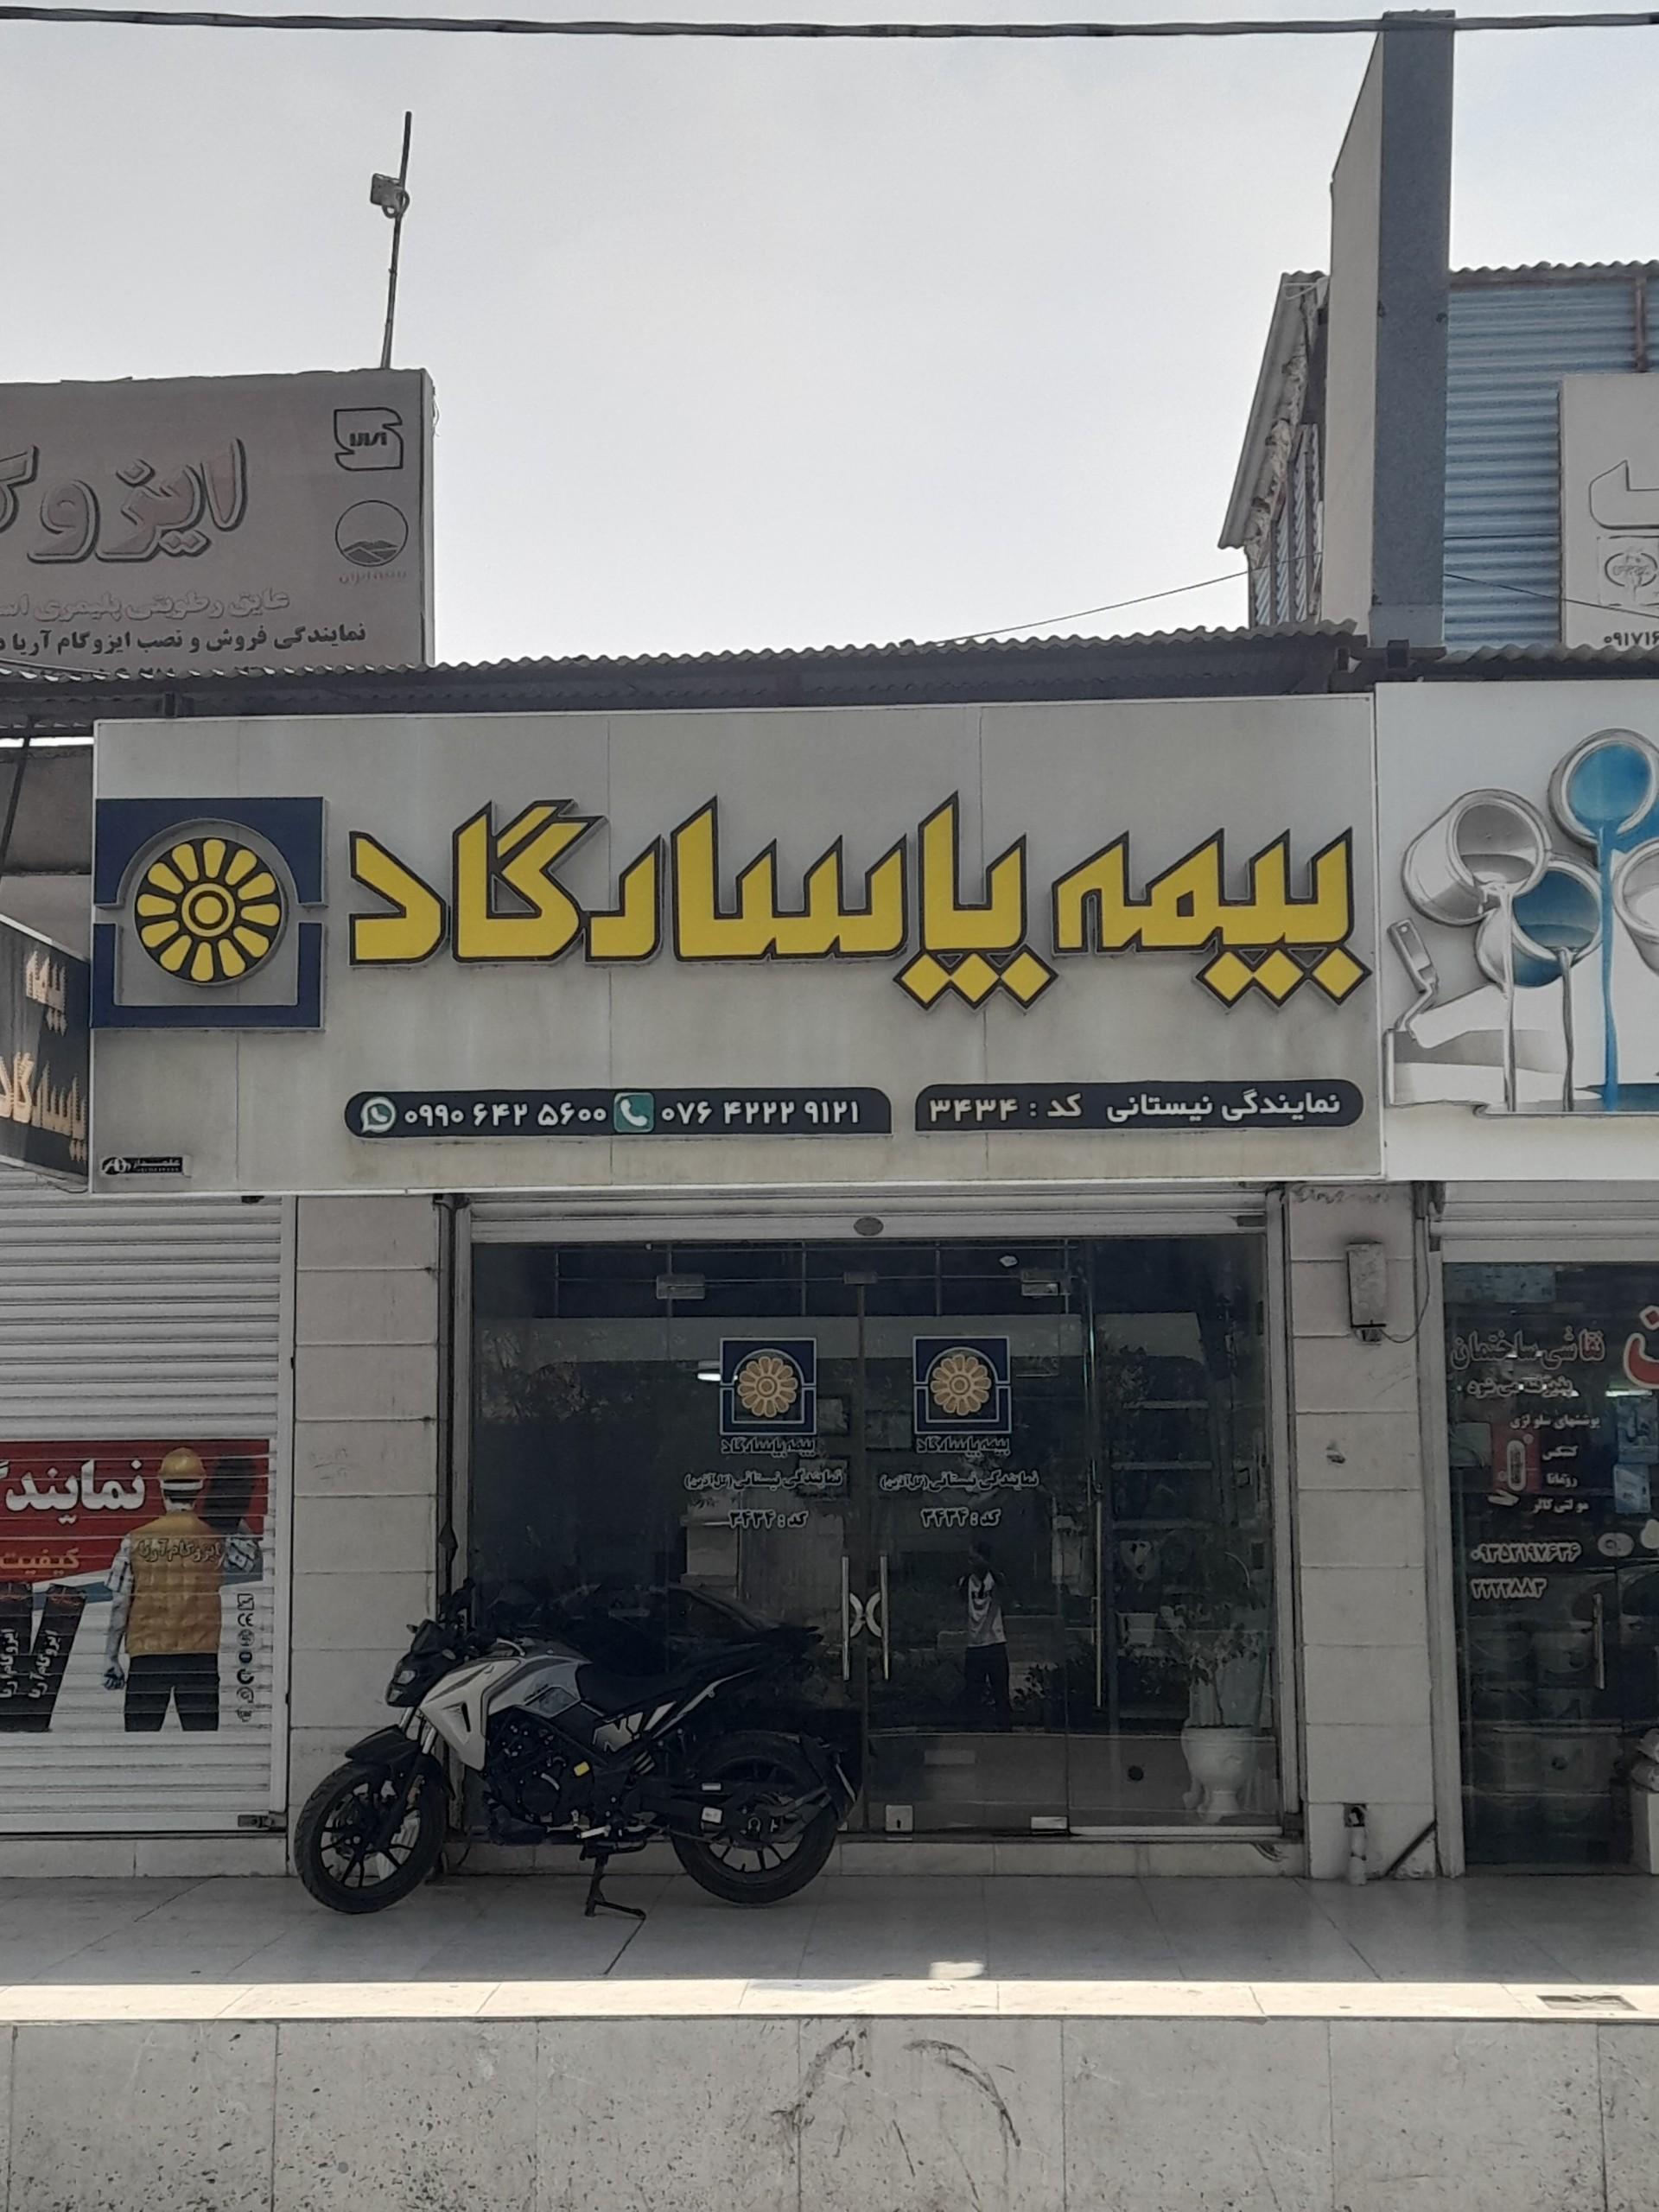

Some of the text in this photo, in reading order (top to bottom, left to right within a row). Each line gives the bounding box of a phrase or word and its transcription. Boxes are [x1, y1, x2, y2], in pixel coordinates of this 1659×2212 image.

[12, 630, 52, 657] آریا
[137, 630, 183, 654] نصب
[188, 636, 200, 653] و
[206, 624, 268, 652] فروش
[349, 790, 1374, 1011] بیمه پاسارگاد
[404, 1102, 607, 1127] ۰۹۹۰ ۶۴۲ ۵۶۰۰
[661, 1101, 859, 1124] ۰۷۶ ۴۲۲۲ ۹۱۲۱
[929, 1096, 1019, 1123] ۳۴۳۴
[1047, 1092, 1083, 1118] کد
[1106, 1091, 1213, 1123] نیستانی
[1221, 1087, 1340, 1122] نمایندگی
[1451, 1329, 1541, 1370] ساختمان
[721, 1436, 816, 1459] بیمه پاسارگاد
[916, 1435, 1012, 1459] بیمه پاسارگاد
[733, 1470, 782, 1492] نیستانی
[783, 1467, 843, 1489] نمایندگی
[927, 1471, 978, 1493] نیستانی
[977, 1469, 1040, 1491] نمایندگی
[728, 1509, 777, 1529] ۳۴۳۴
[787, 1510, 810, 1529] کد
[920, 1506, 970, 1529] ۳۴۳۴
[979, 1509, 1001, 1527] کد
